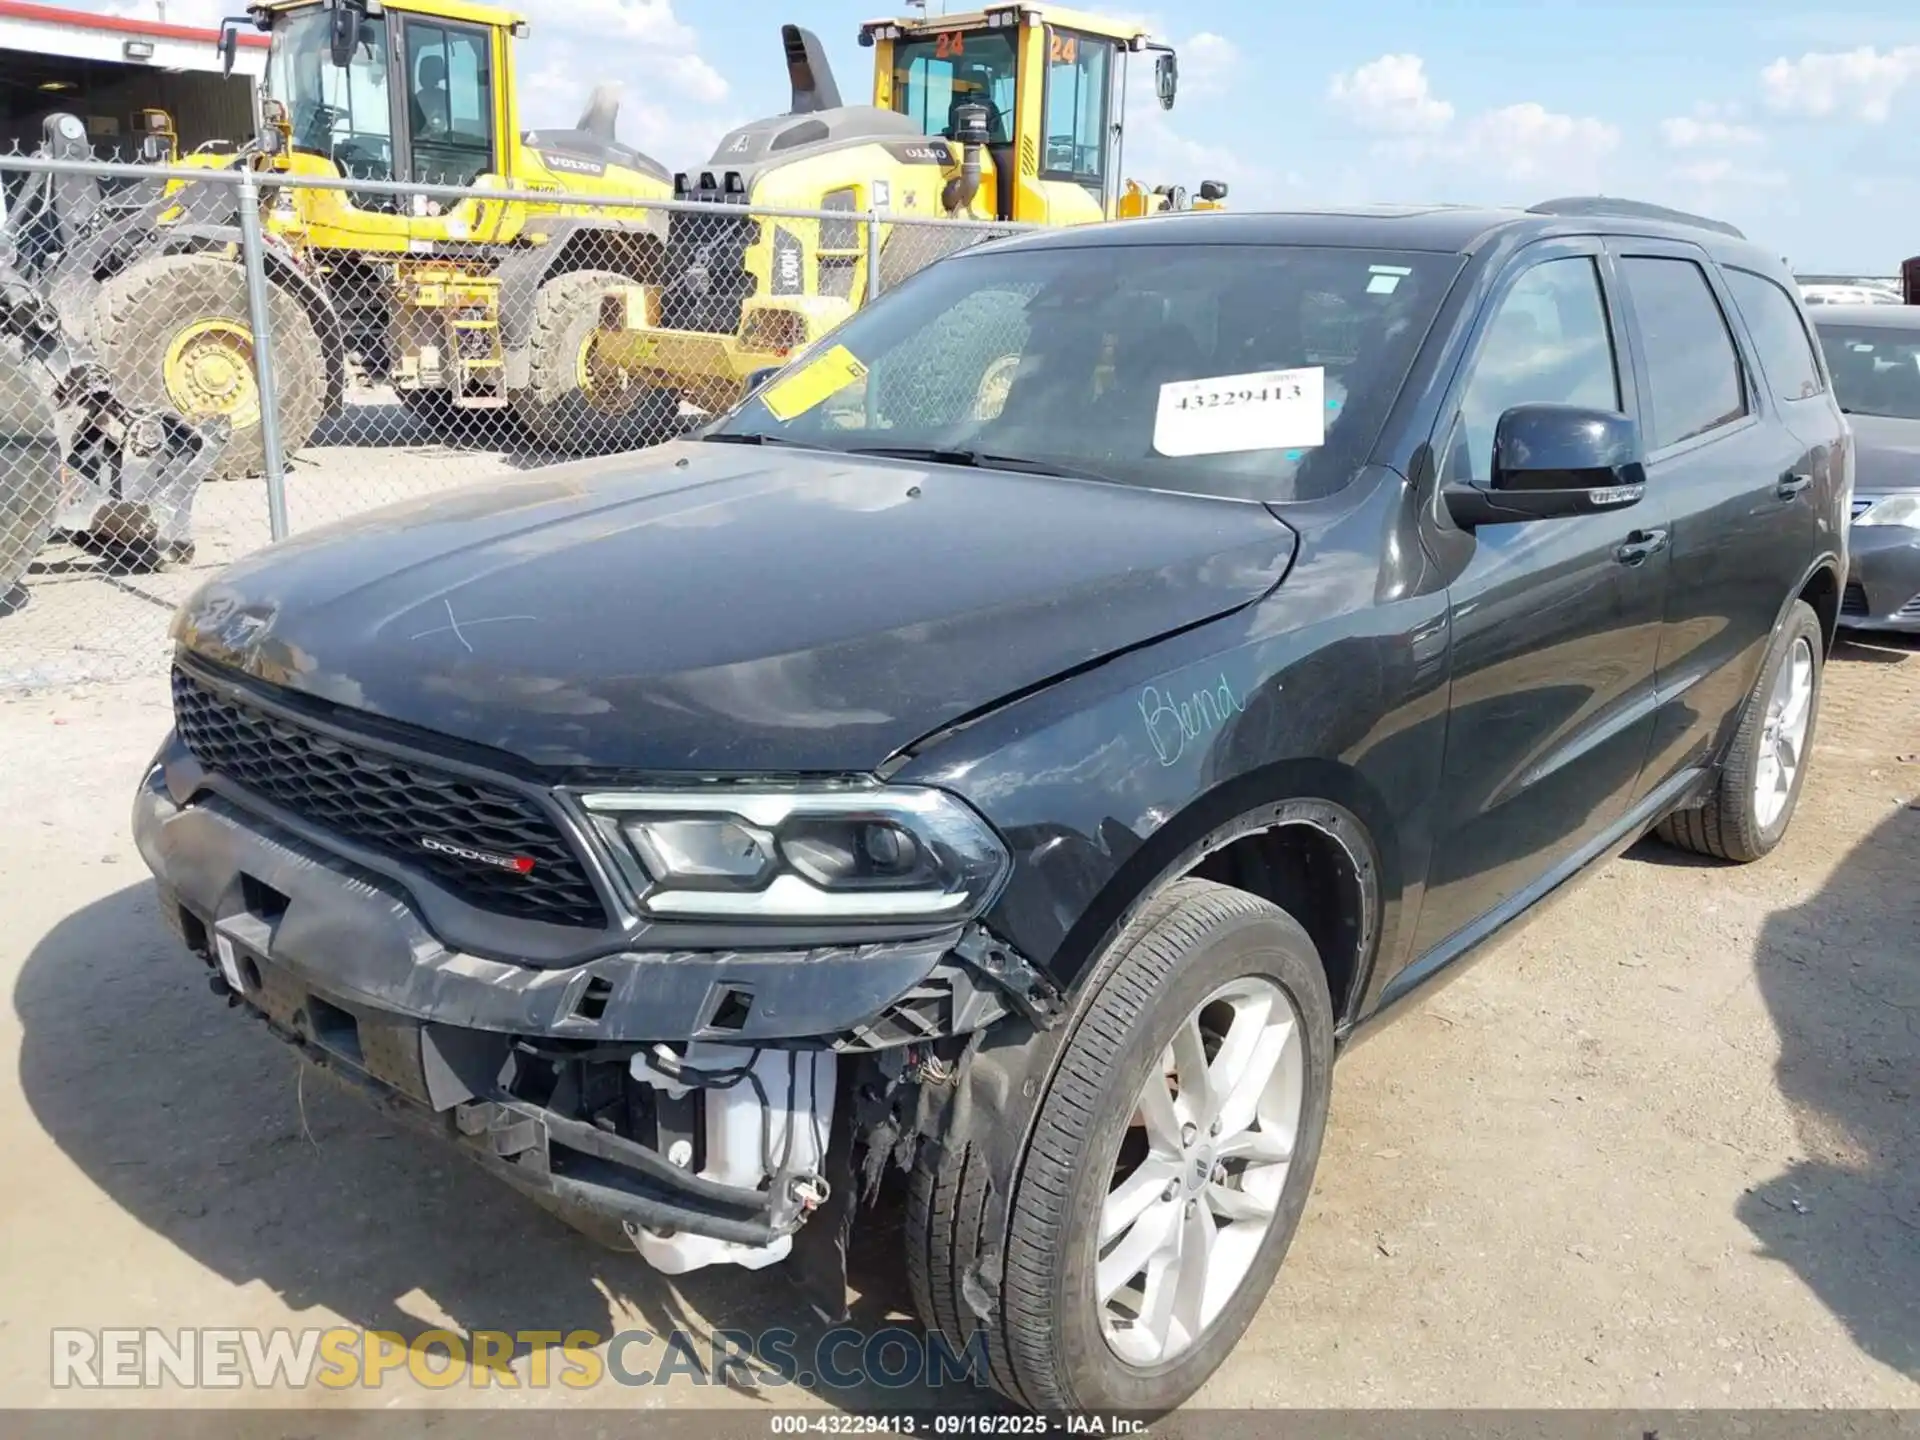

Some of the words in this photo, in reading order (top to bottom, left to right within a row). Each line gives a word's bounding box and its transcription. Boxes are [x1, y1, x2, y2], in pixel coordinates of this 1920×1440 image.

[935, 32, 964, 58] 24
[1051, 34, 1076, 63] 24
[545, 156, 602, 173] VOLVO
[1174, 384, 1302, 411] 43229413
[1138, 672, 1247, 767] Blend
[422, 837, 520, 872] DODGE
